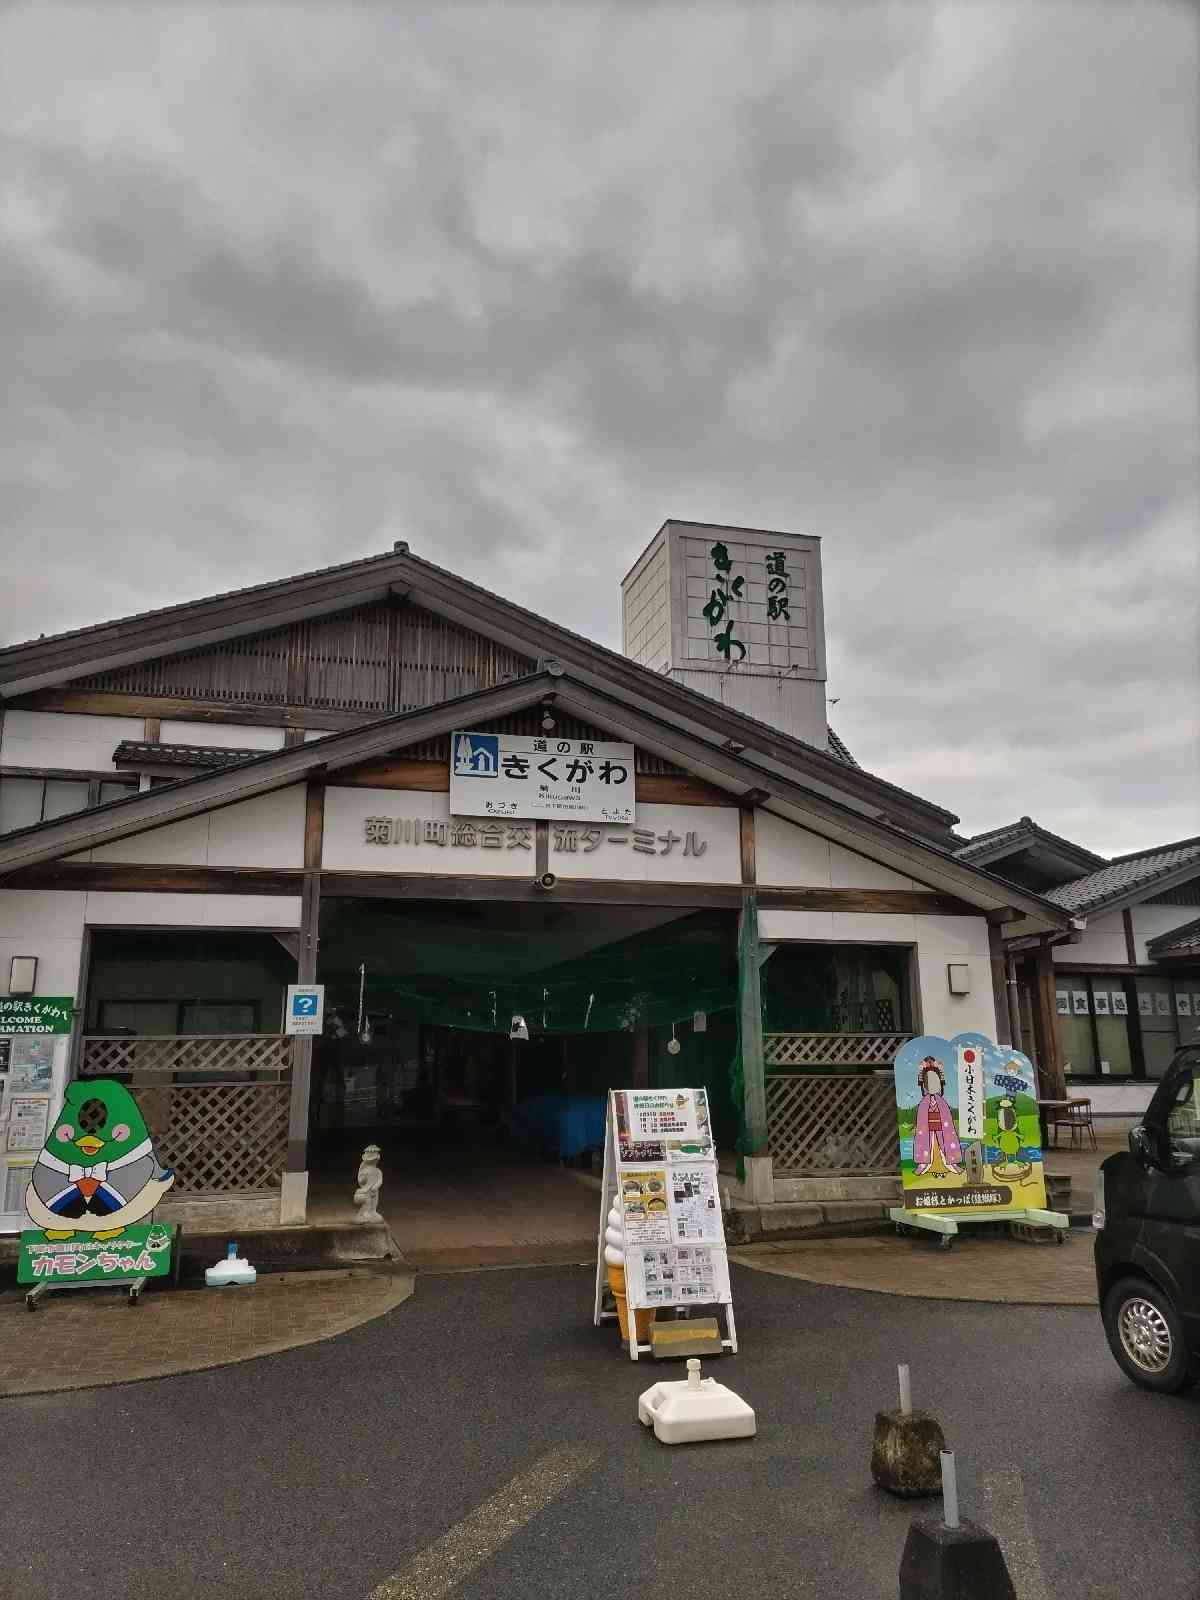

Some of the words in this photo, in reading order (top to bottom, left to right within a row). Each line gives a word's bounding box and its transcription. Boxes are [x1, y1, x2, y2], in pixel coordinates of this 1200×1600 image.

[765, 551, 791, 621] 道の駅
[702, 542, 747, 663] きくがわ
[533, 738, 595, 755] 道の駅
[501, 754, 628, 785] きくがわ
[32, 1249, 157, 1276] カモンちゃん
